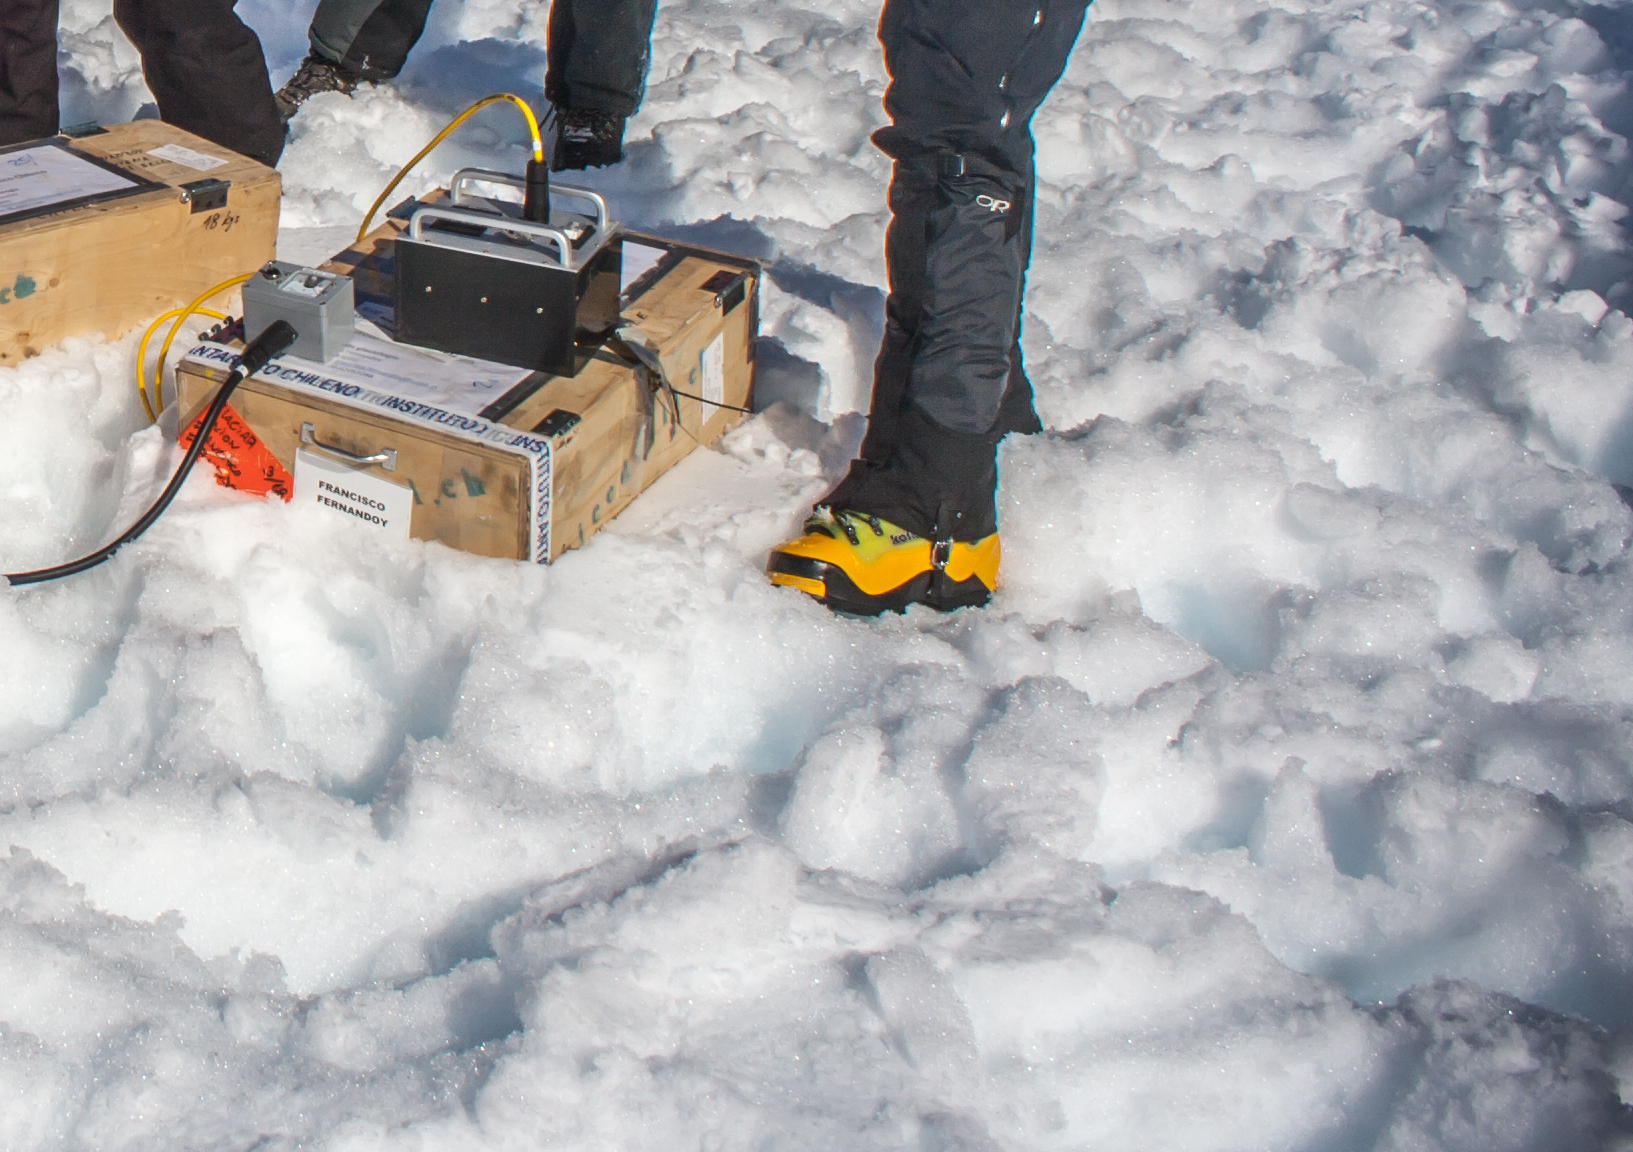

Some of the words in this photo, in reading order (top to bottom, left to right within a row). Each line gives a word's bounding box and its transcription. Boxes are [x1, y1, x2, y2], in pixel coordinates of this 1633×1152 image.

[203, 212, 220, 230] 18
[281, 367, 361, 397] CHILENO
[381, 395, 476, 431] INSTITUTO
[316, 494, 389, 528] FERNANDOY
[318, 479, 386, 512] FRANCISCO
